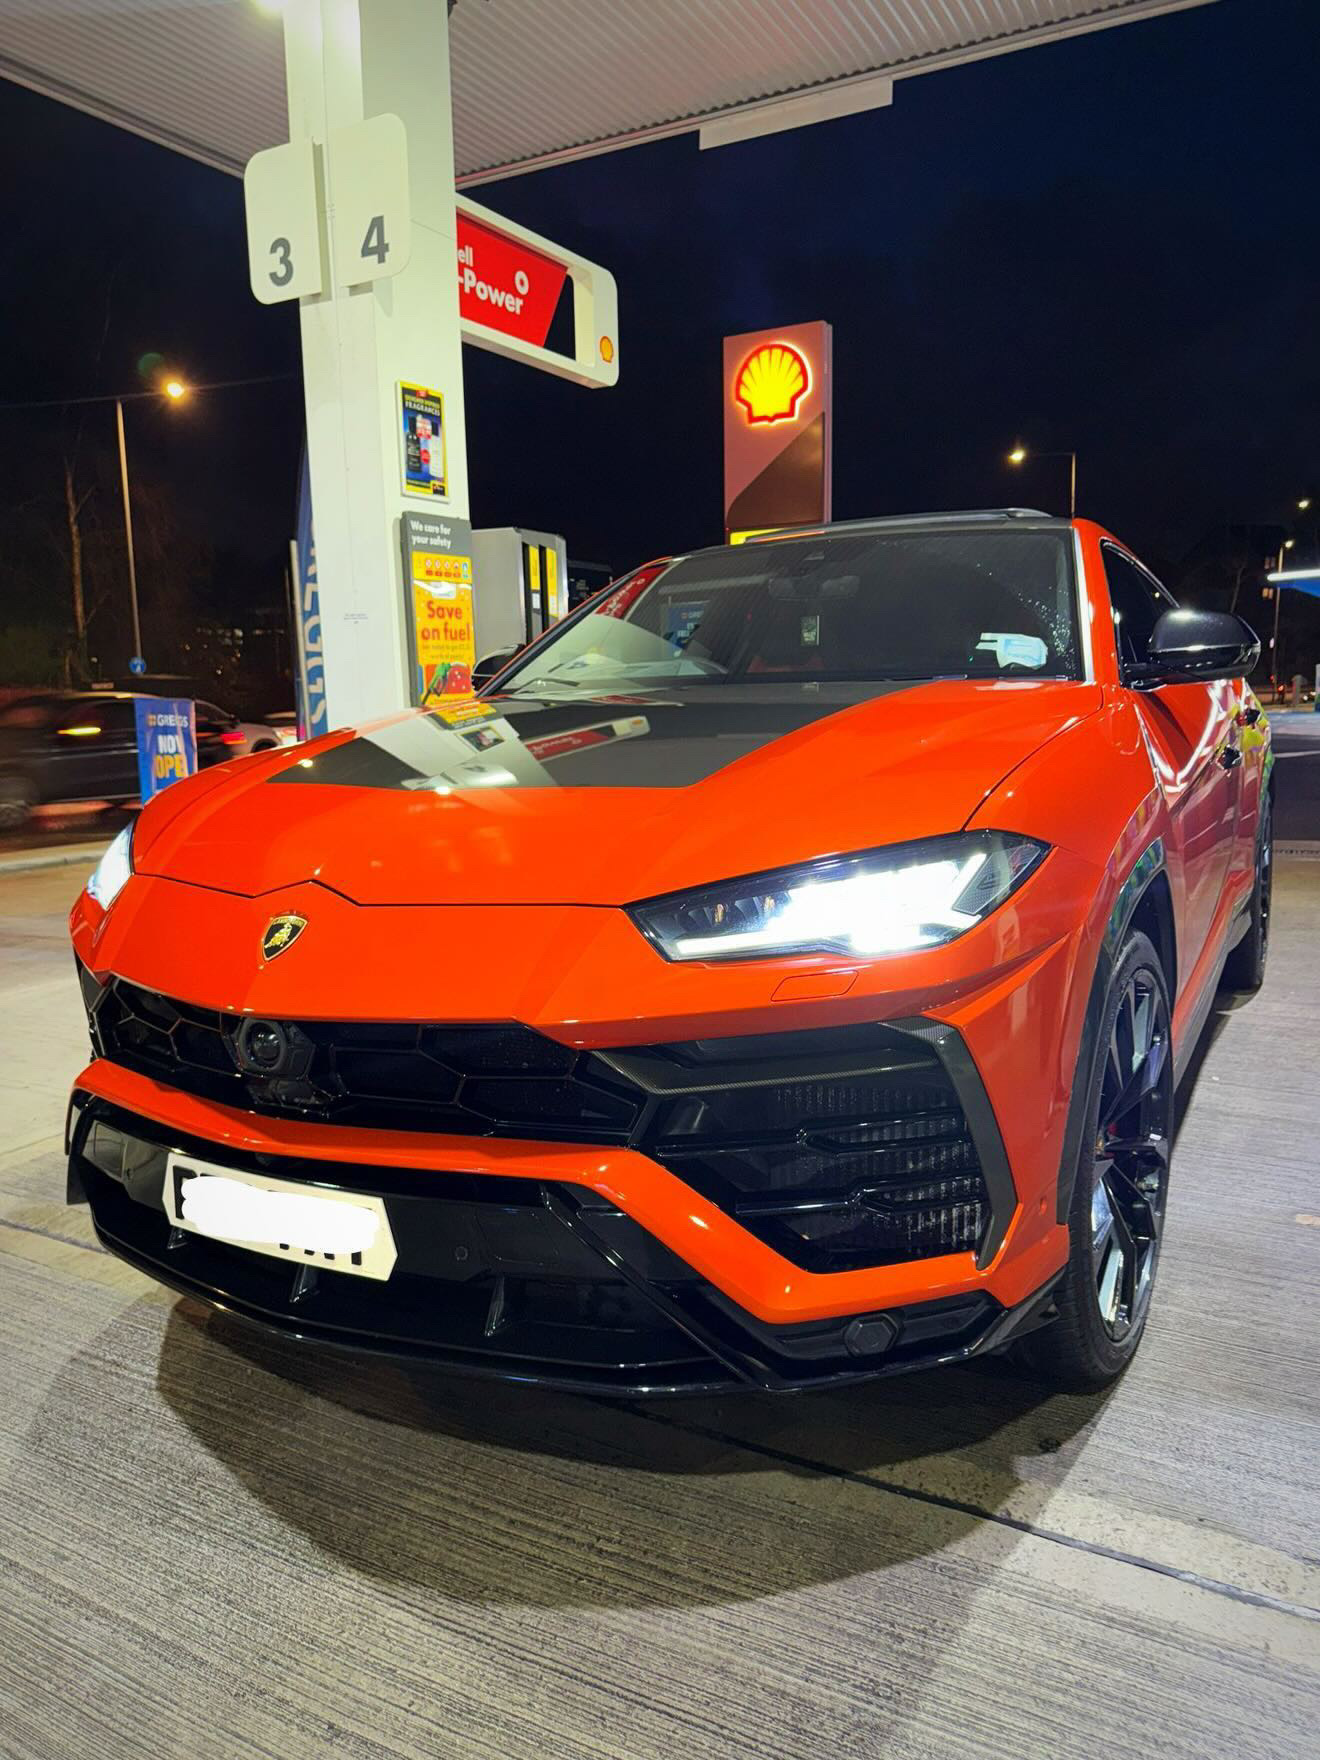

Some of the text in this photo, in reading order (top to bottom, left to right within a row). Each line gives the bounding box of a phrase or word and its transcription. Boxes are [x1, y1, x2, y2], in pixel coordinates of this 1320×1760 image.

[360, 214, 390, 265] 4
[268, 236, 294, 288] 3
[457, 244, 474, 268] ell
[457, 267, 524, 316] -Power
[410, 519, 451, 536] We care for
[411, 535, 452, 549] your safety
[427, 599, 463, 620] Save
[421, 621, 471, 641] on fuel
[155, 755, 185, 778] OPE
